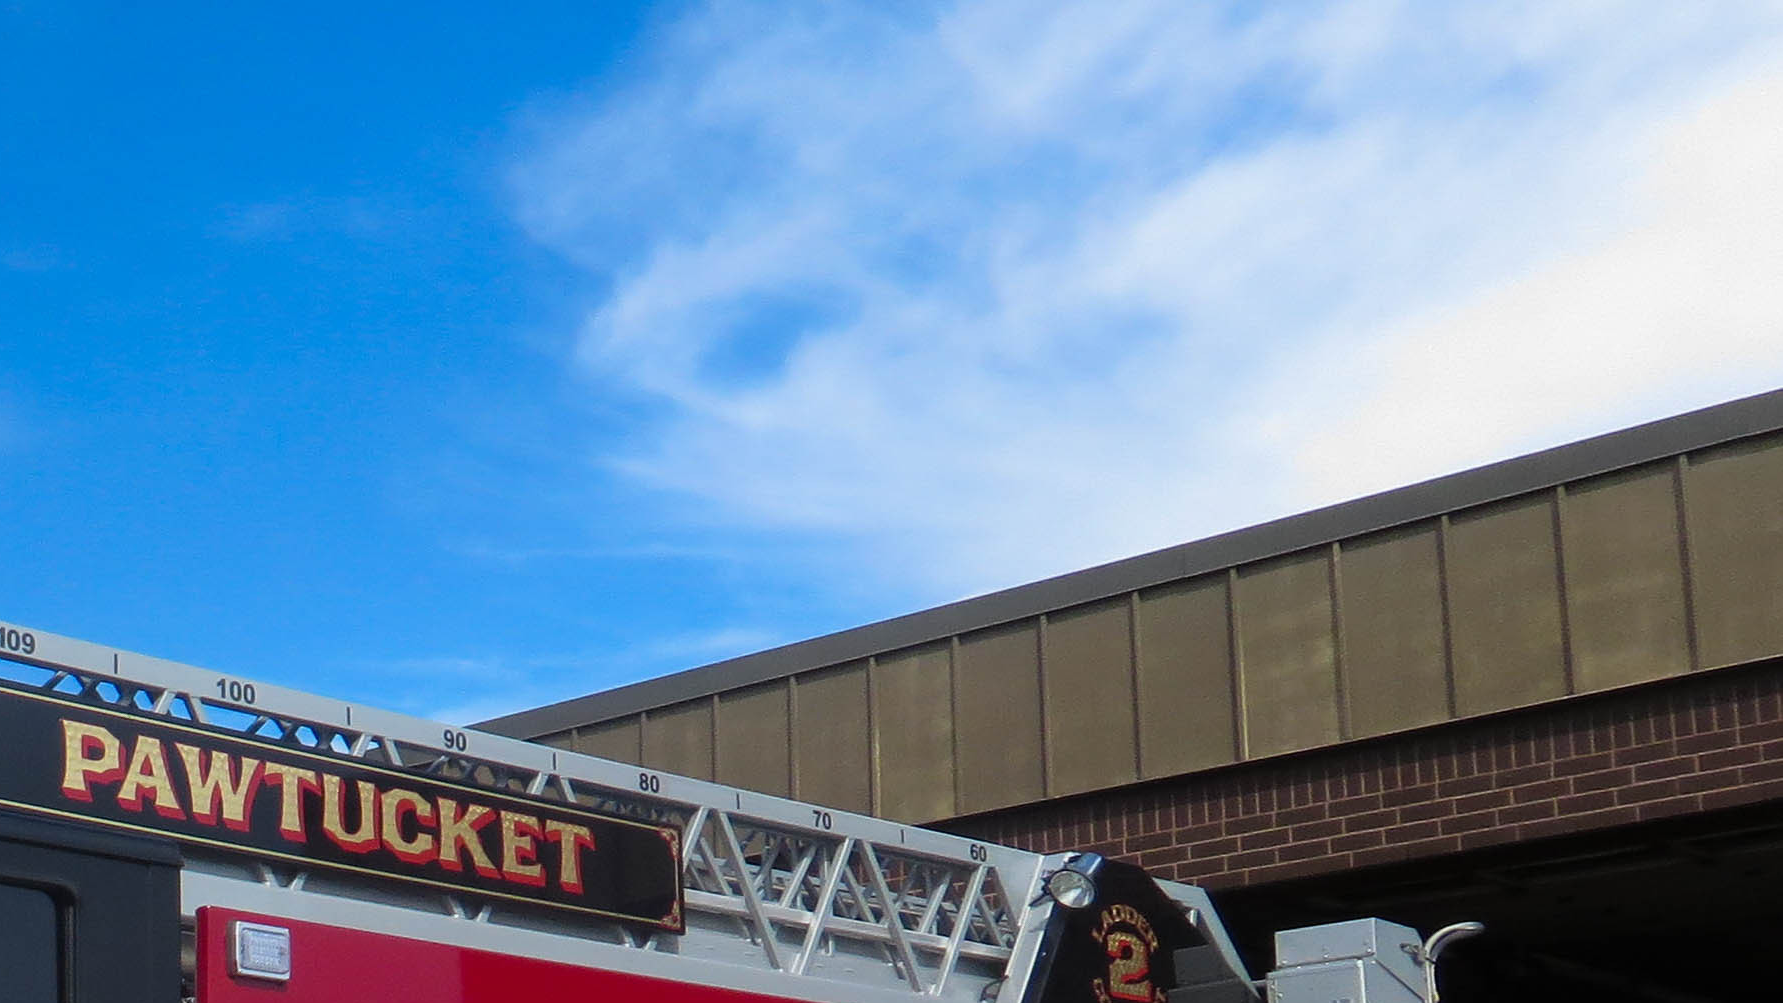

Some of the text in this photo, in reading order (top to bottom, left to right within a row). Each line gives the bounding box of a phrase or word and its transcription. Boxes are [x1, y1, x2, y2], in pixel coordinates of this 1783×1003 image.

[216, 677, 256, 705] 100
[443, 729, 467, 752] 90
[638, 772, 660, 794] 80
[60, 718, 595, 894] PAWTUCKET
[812, 809, 833, 831] 70
[969, 843, 988, 863] 60
[1091, 903, 1159, 953] LADDER
[1106, 931, 1152, 1003] 2
